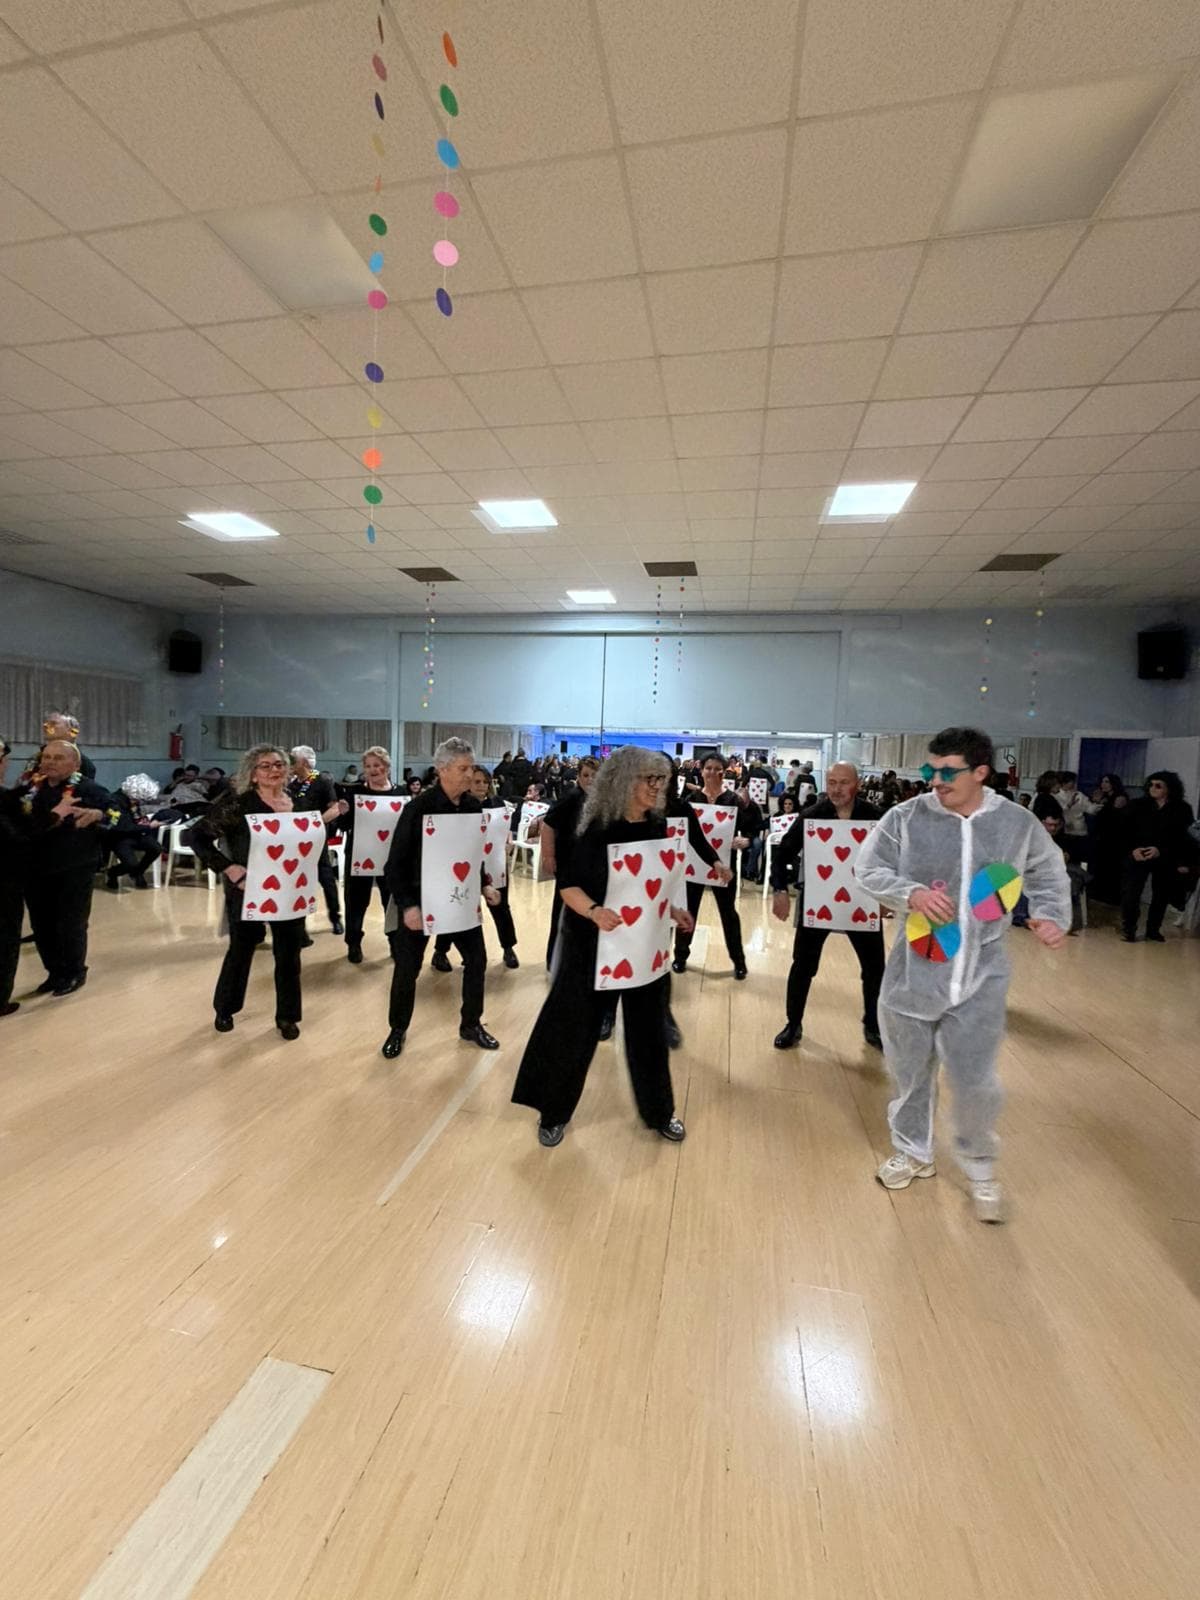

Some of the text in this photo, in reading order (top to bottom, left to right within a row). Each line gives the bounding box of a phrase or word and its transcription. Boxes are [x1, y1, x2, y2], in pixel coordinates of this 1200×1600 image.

[252, 814, 258, 824] 9
[426, 815, 434, 827] A
[481, 814, 487, 825] A
[678, 819, 685, 828] 4
[807, 820, 814, 830] 8
[675, 838, 682, 851] 7
[612, 845, 620, 858] 7
[246, 909, 254, 920] 9
